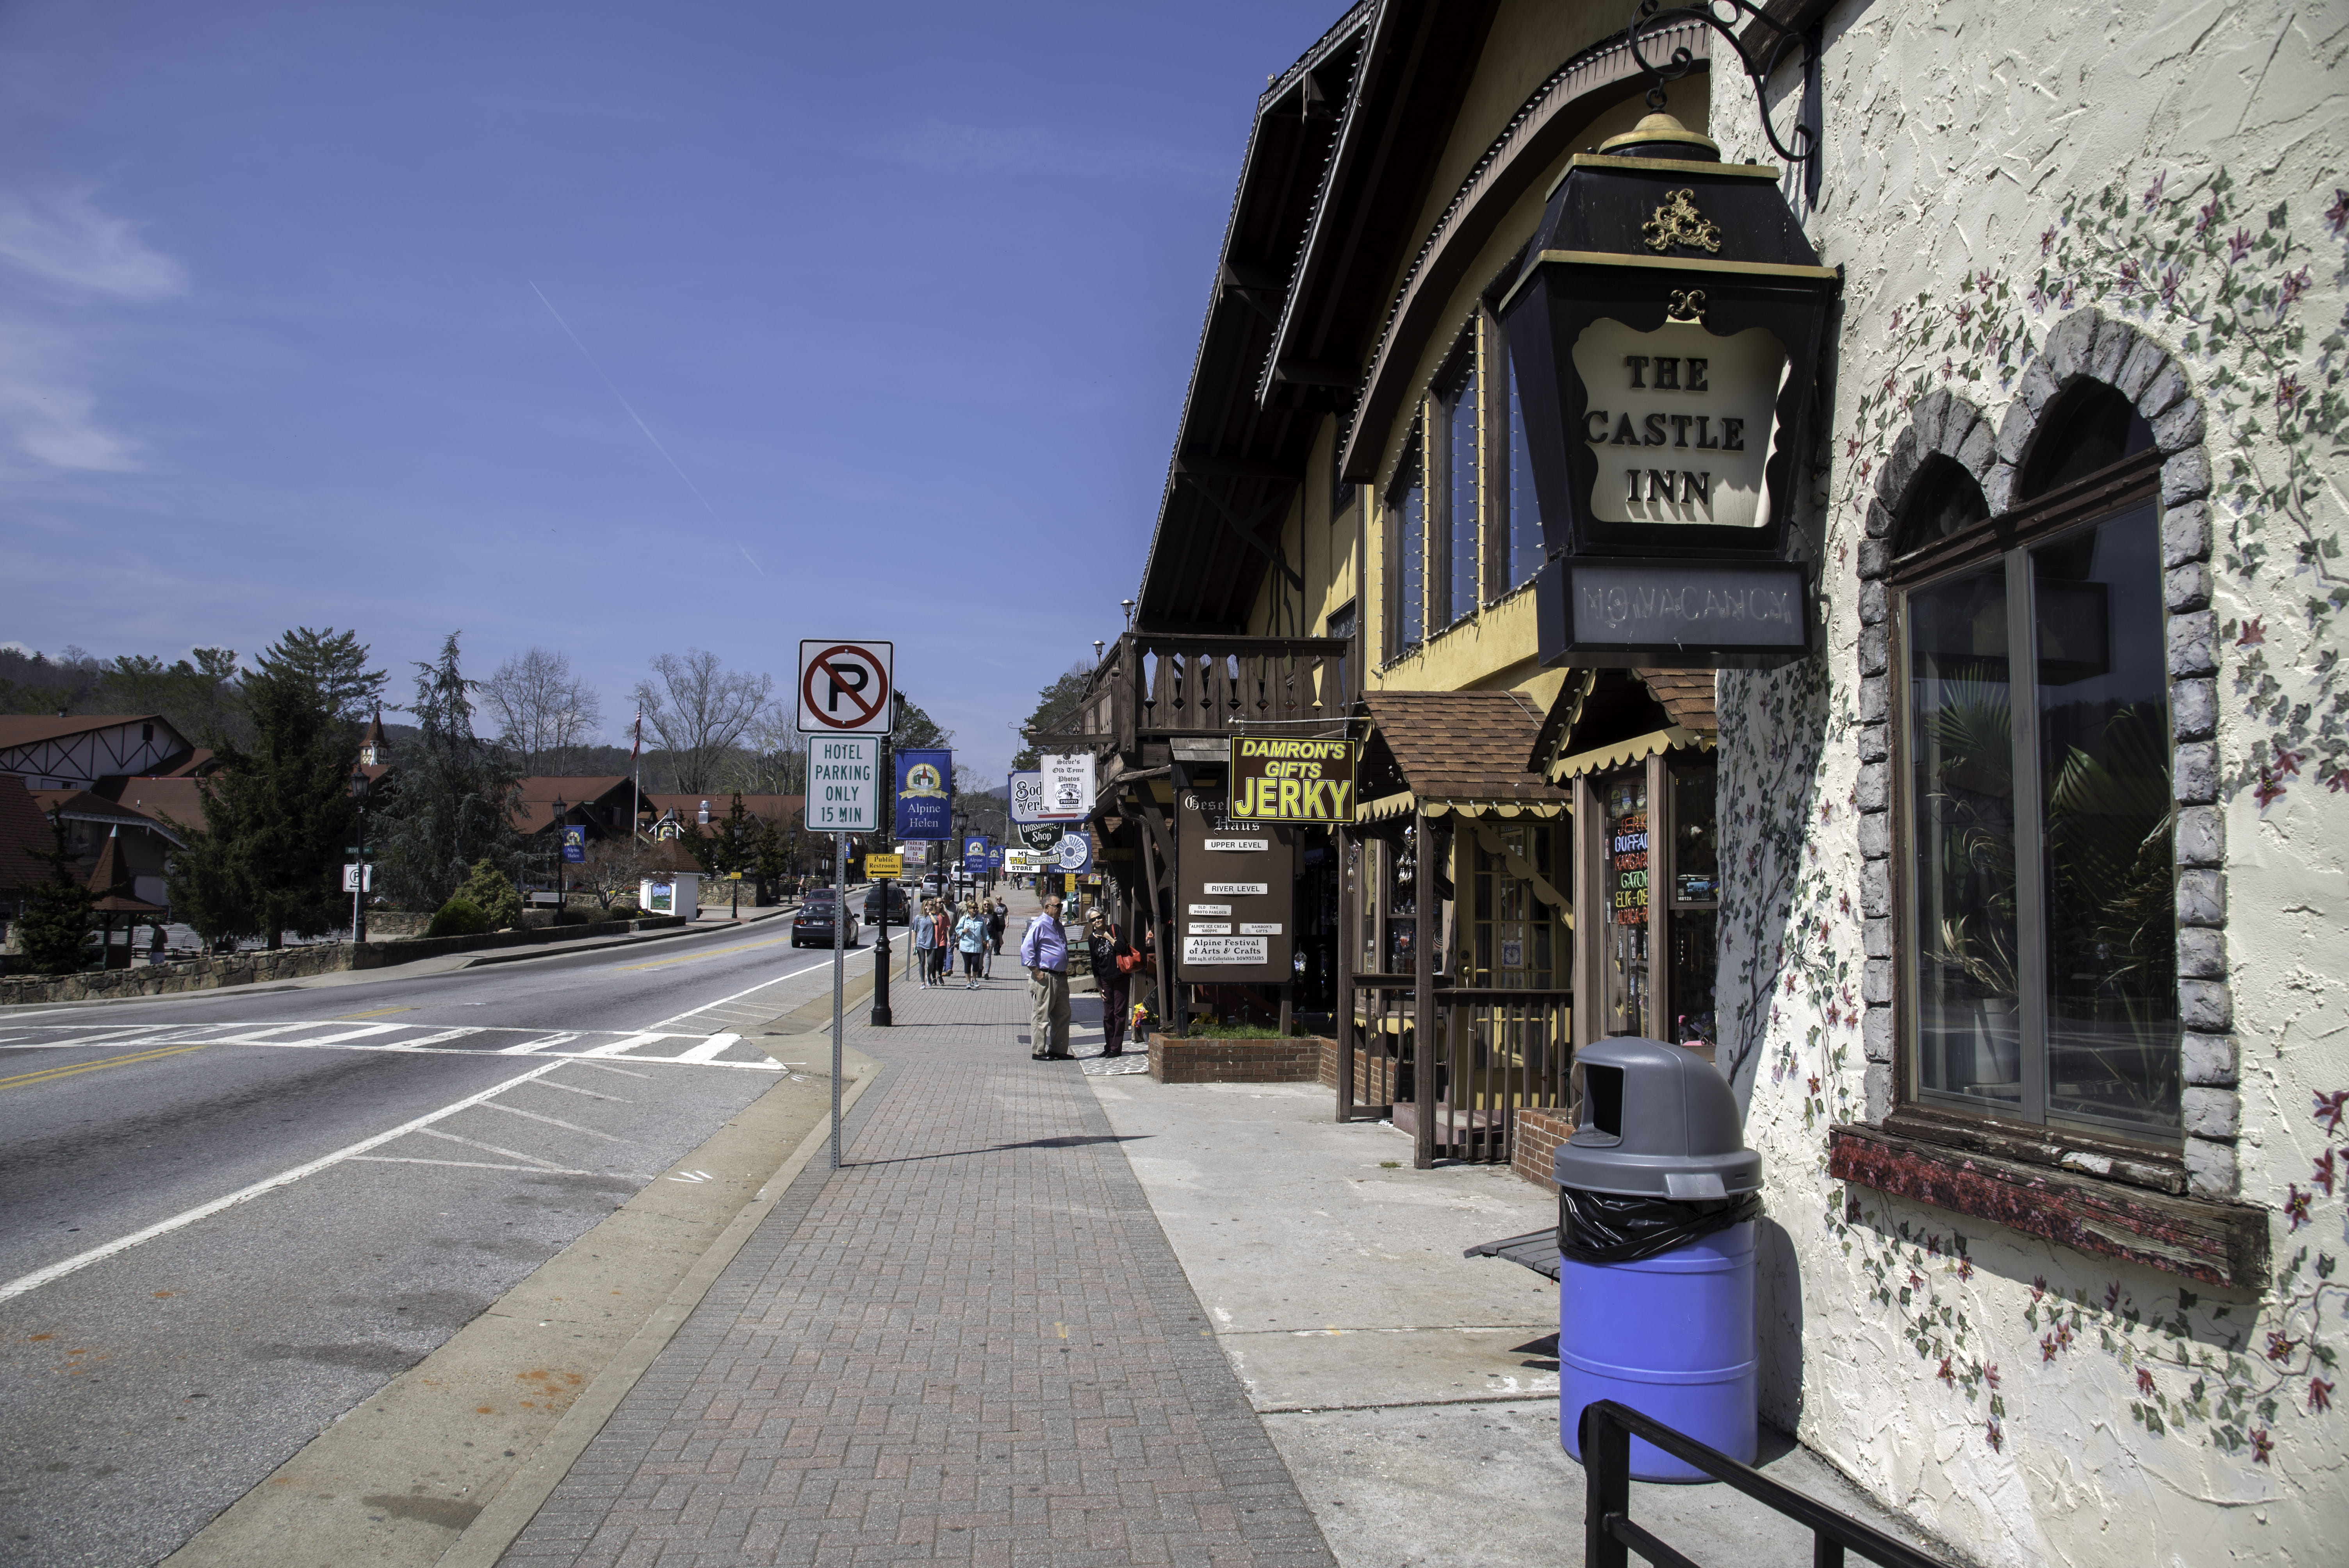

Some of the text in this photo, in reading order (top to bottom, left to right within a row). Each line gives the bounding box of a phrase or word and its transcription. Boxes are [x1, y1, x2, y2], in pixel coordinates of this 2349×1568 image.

[1626, 355, 1708, 392] THE
[1583, 410, 1744, 451] CASTLE
[1626, 469, 1710, 506] INN
[1636, 586, 1788, 624] VACANCY
[829, 663, 869, 712] P
[824, 744, 863, 759] HOTEL
[1241, 740, 1346, 759] DAMRON'S
[816, 765, 870, 780] PARKING
[1264, 761, 1322, 779] GIFTS
[826, 786, 859, 801] ONLY
[1234, 777, 1351, 818] JERKY
[821, 807, 862, 822] 15 MIN
[907, 803, 941, 815] Alpine
[909, 818, 939, 827] Helen
[1213, 816, 1260, 835] Haus
[1618, 814, 1647, 836] JERK
[1032, 831, 1052, 842] Shop
[1069, 836, 1085, 853] RIVER
[1075, 854, 1084, 863] CO.
[1615, 852, 1648, 871] KANGAR
